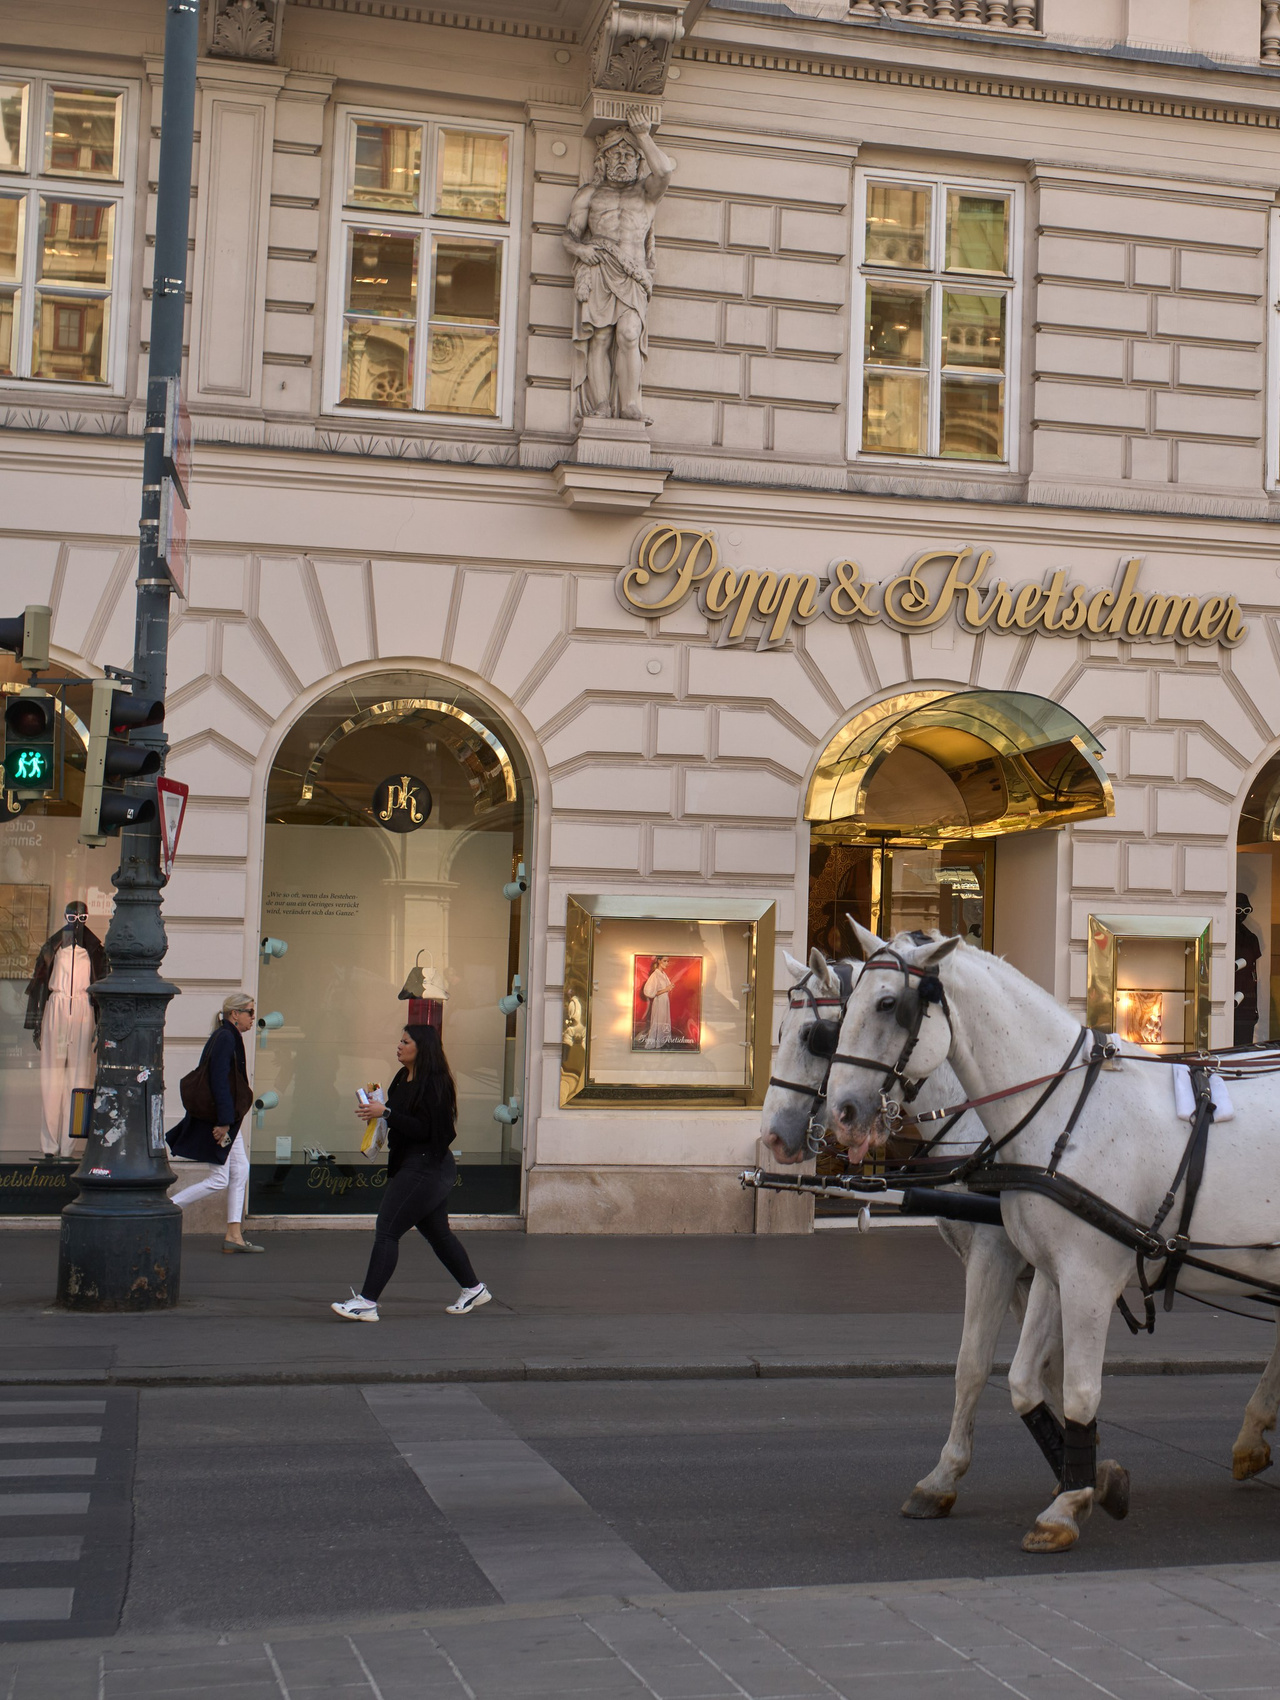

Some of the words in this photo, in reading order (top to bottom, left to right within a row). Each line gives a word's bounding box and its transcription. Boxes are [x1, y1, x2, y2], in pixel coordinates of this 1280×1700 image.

[622, 524, 820, 642] Popp
[830, 559, 881, 618] &
[884, 547, 1247, 642] Kretschmer
[307, 1166, 353, 1195] Popp
[355, 1172, 369, 1188] &
